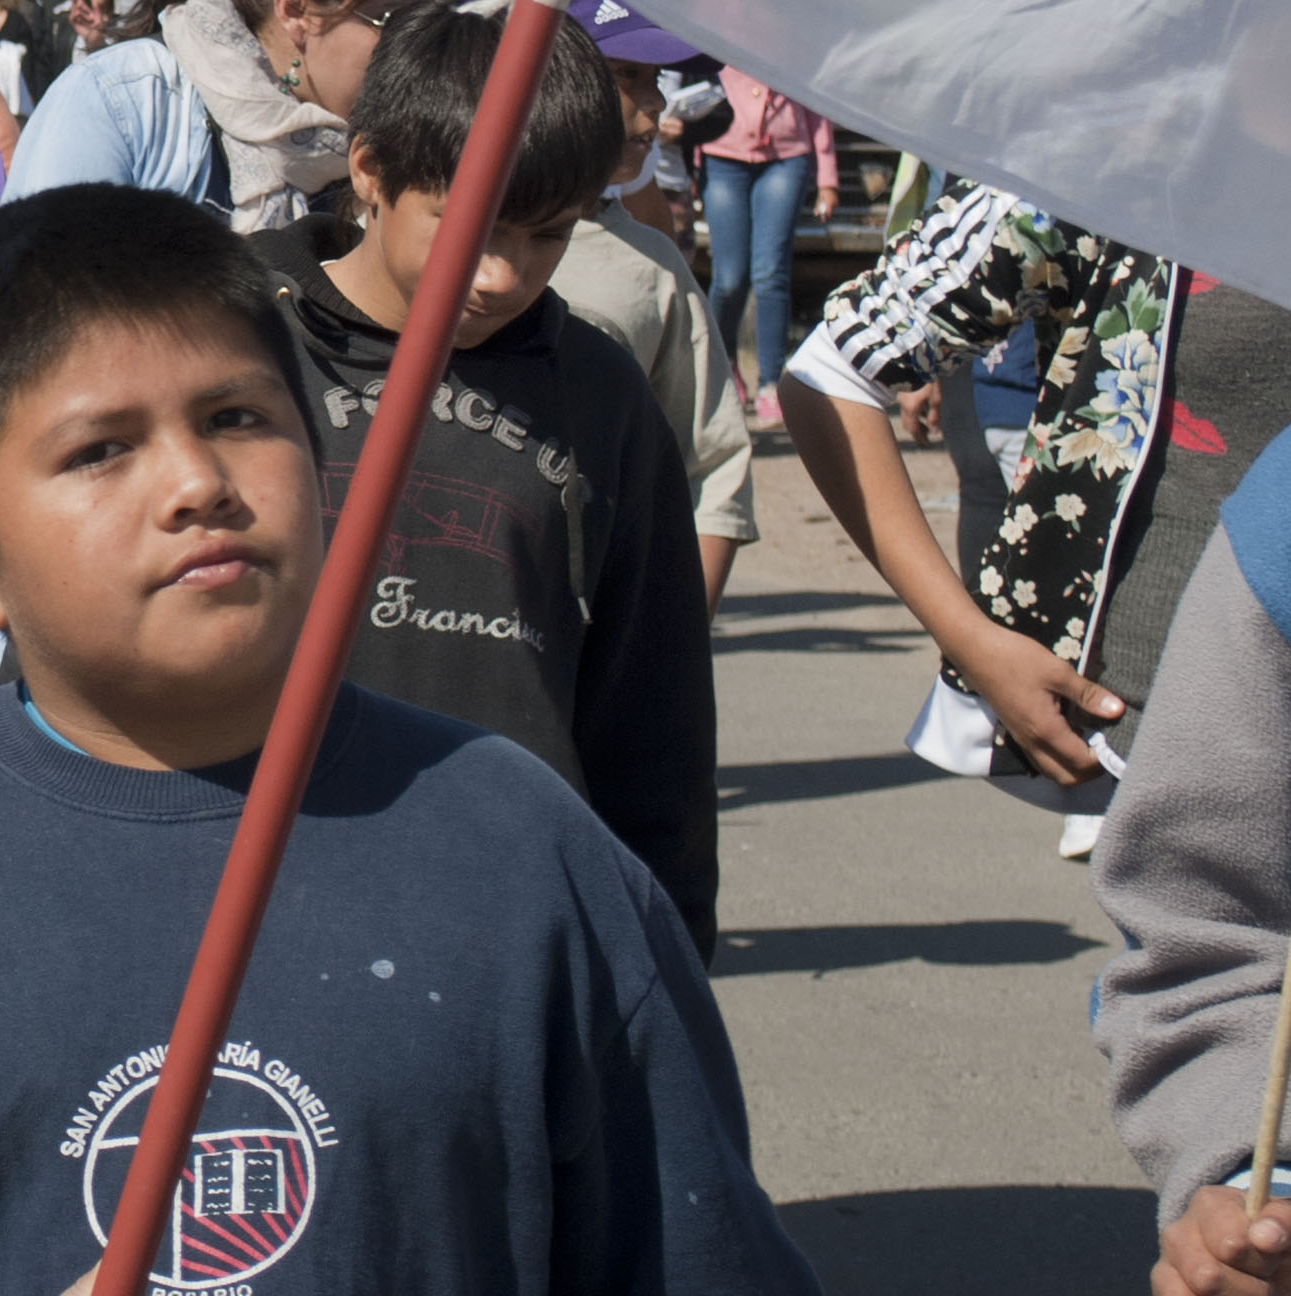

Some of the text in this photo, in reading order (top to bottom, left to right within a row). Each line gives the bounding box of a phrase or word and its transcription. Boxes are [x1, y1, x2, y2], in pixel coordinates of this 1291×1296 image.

[594, 8, 629, 25] adidas
[60, 1107, 98, 1158] SAN
[264, 1059, 339, 1149] GIANELLI
